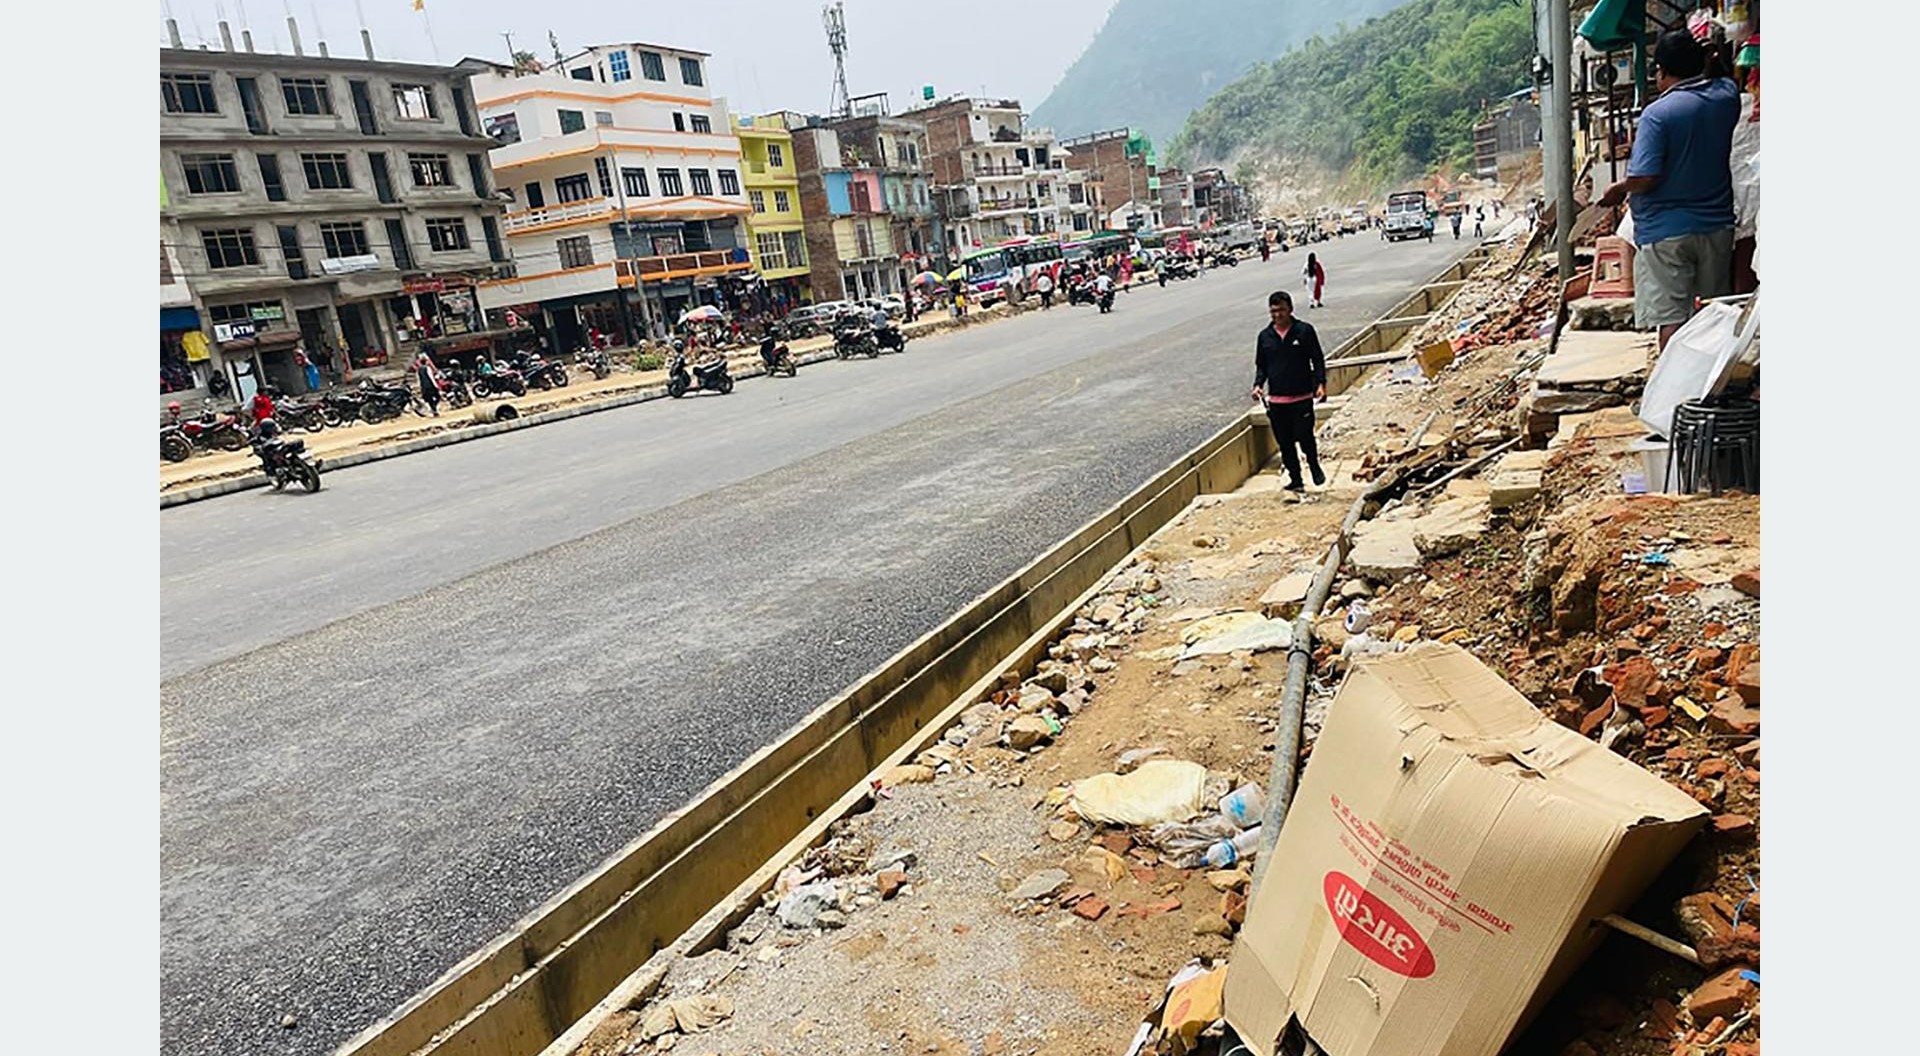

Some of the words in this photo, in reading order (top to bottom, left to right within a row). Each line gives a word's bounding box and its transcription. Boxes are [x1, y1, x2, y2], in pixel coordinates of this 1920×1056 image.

[1425, 876, 1460, 902] आरती
[1333, 884, 1415, 963] आरती
[1465, 902, 1515, 932] उत्पादक
